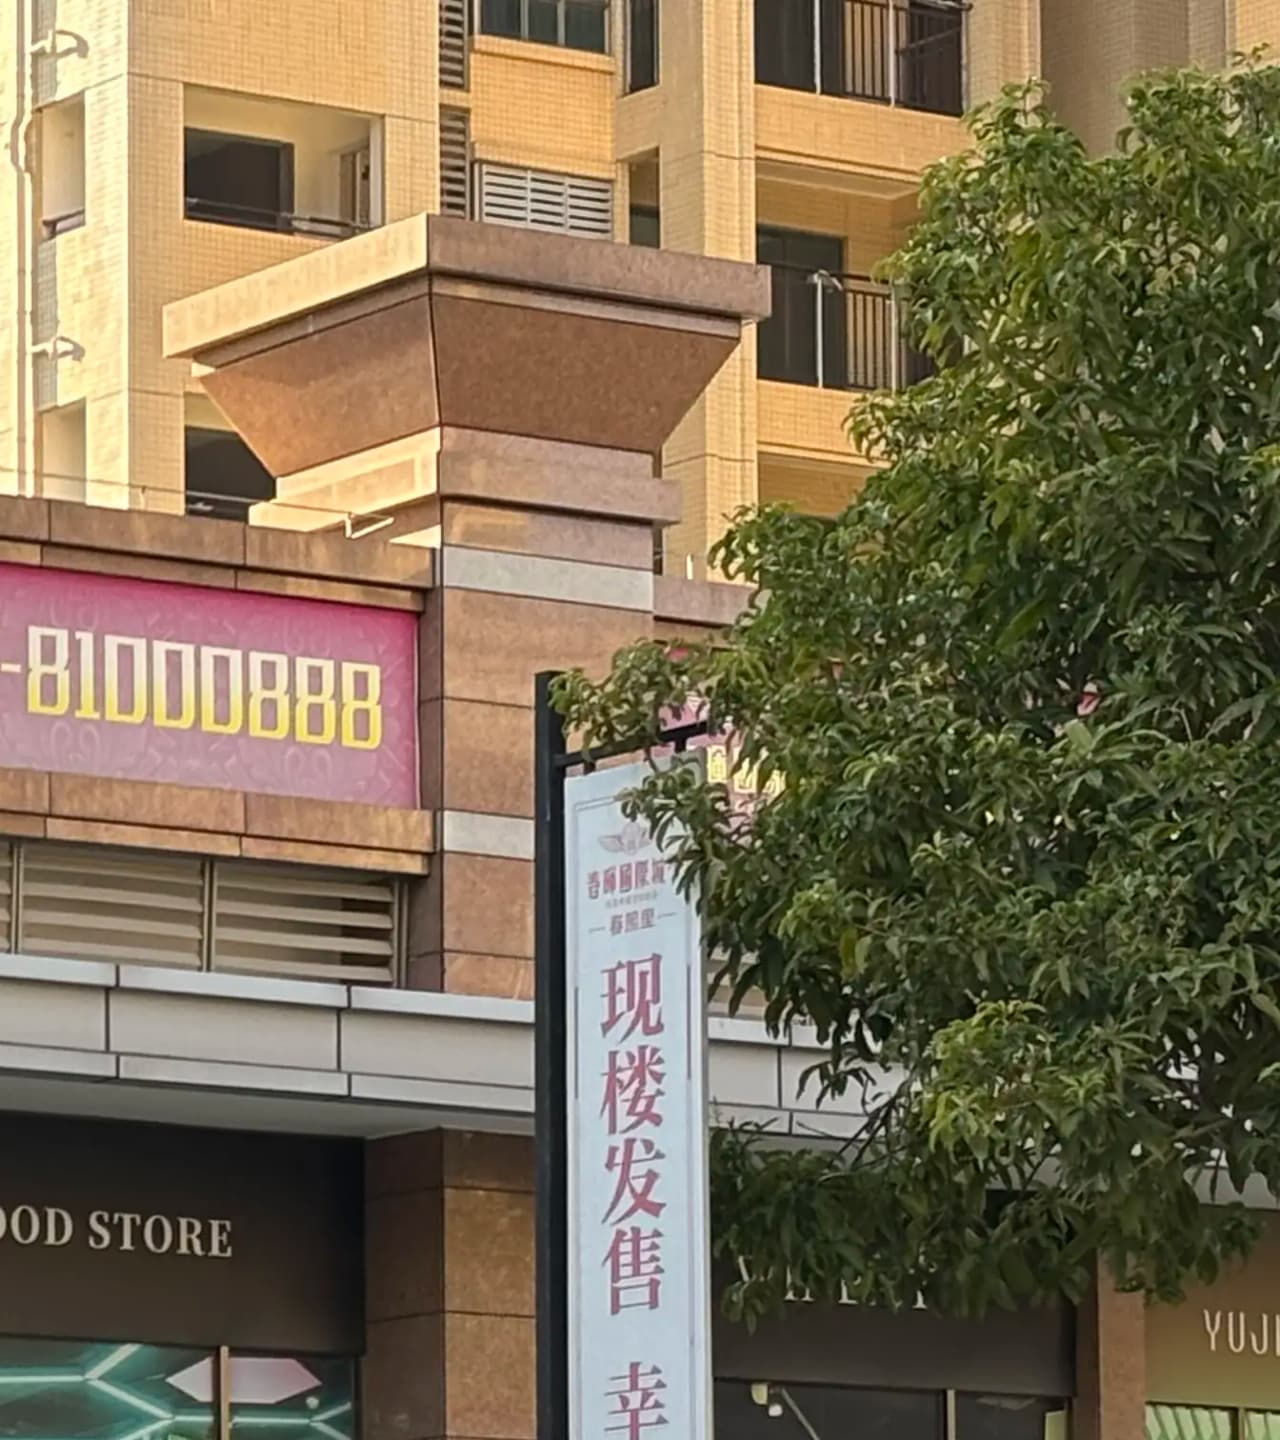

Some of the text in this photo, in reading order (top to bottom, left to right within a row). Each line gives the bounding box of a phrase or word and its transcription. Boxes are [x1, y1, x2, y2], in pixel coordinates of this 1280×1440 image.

[87, 1210, 233, 1258] STORE
[599, 952, 668, 1316] 现楼发售
